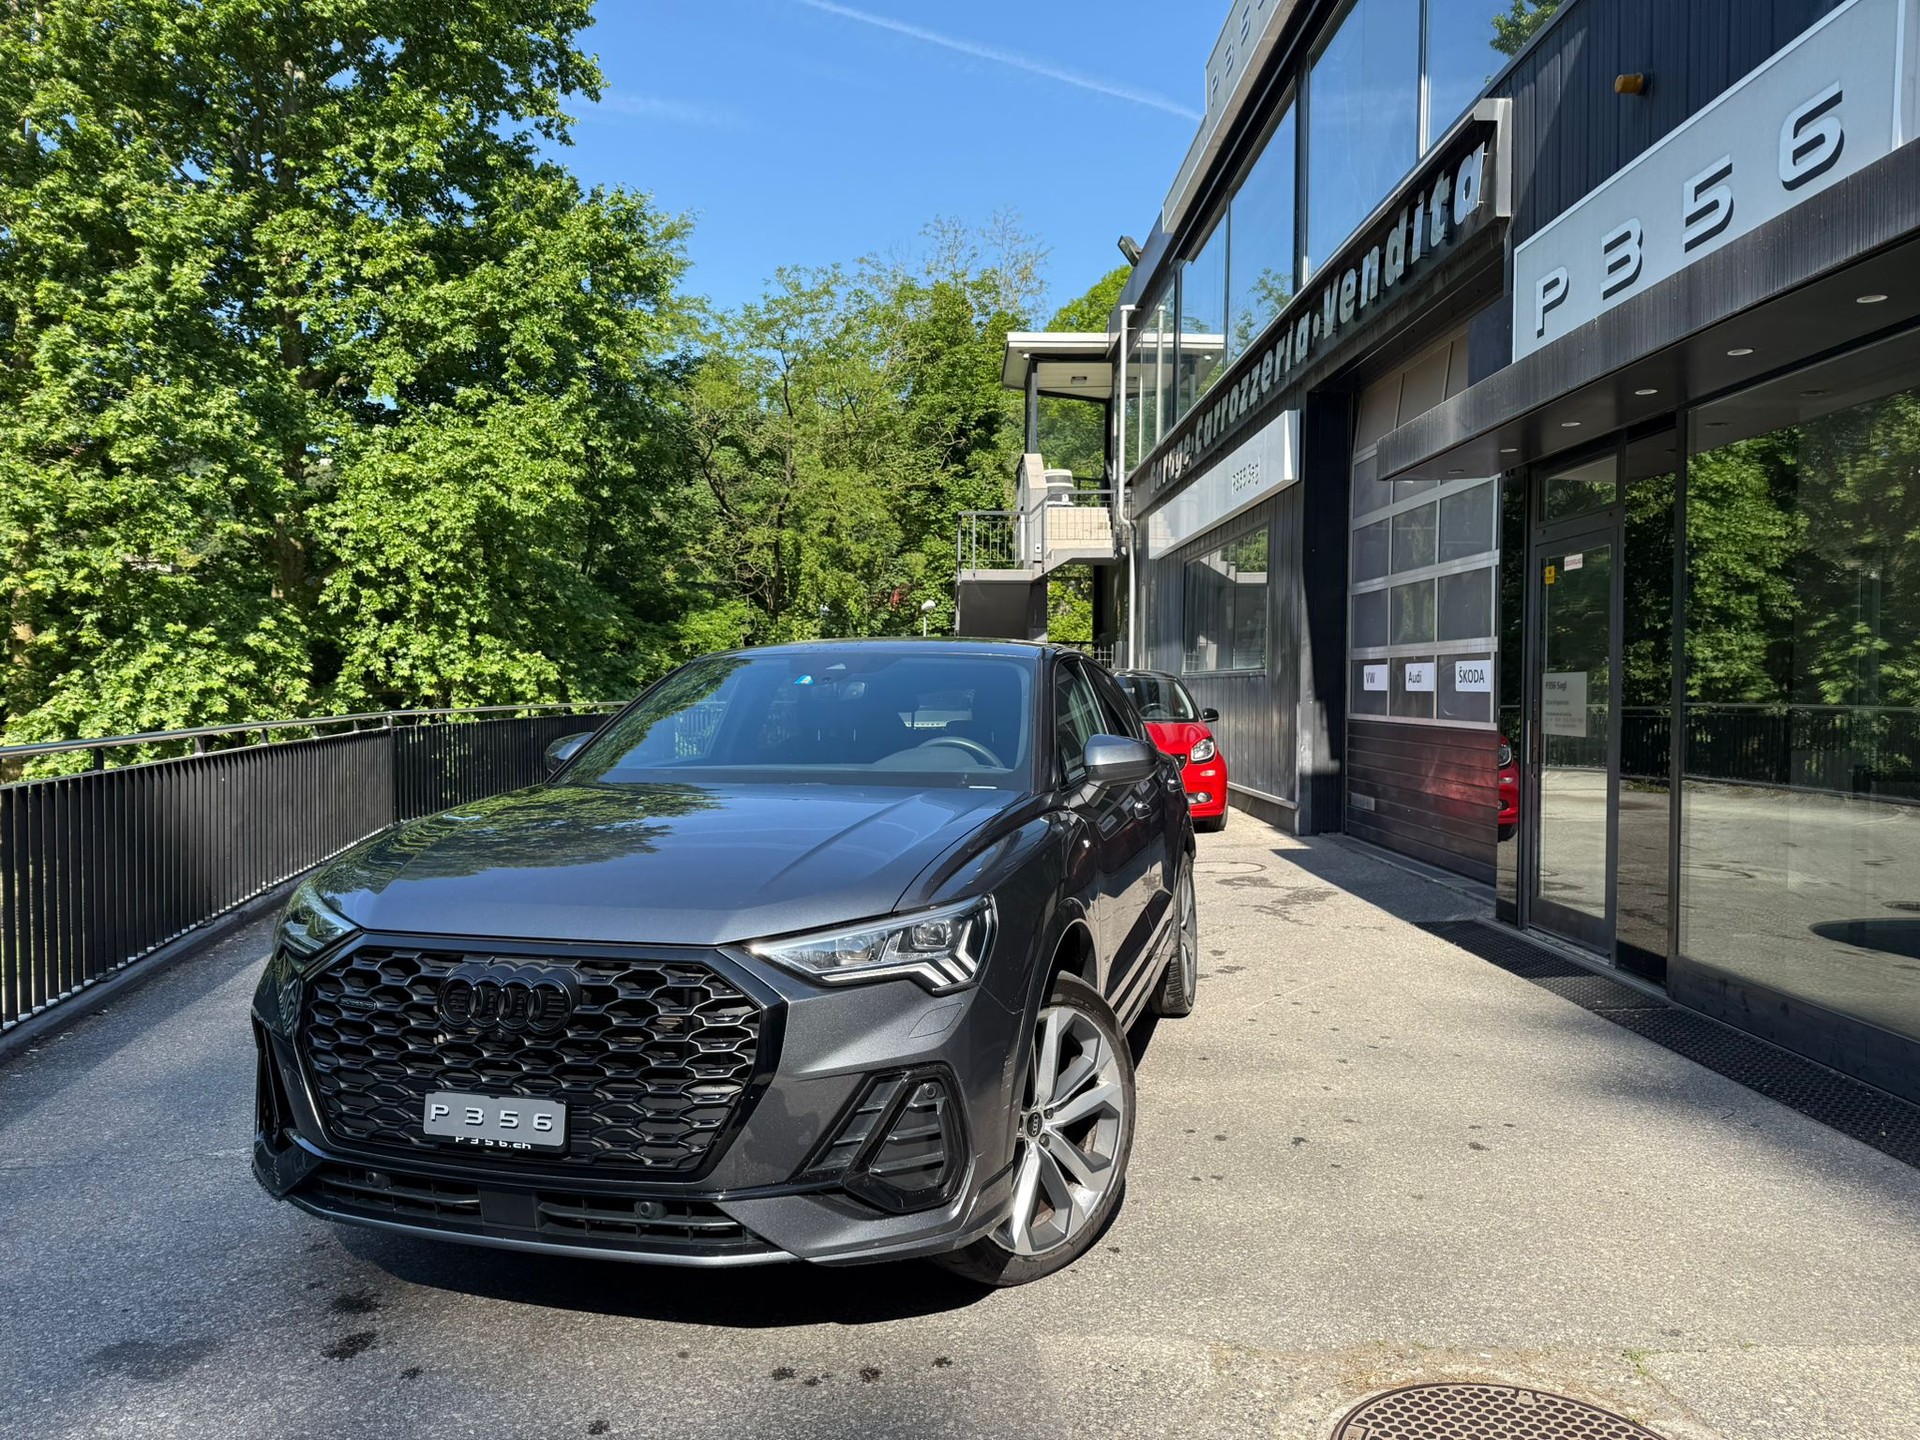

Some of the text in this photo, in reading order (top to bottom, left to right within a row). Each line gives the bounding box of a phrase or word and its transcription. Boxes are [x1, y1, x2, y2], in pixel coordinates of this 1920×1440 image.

[1323, 141, 1485, 339] Vendita
[1365, 671, 1376, 684] VW
[1408, 670, 1422, 684] Audi
[1458, 666, 1485, 684] ŠKODA
